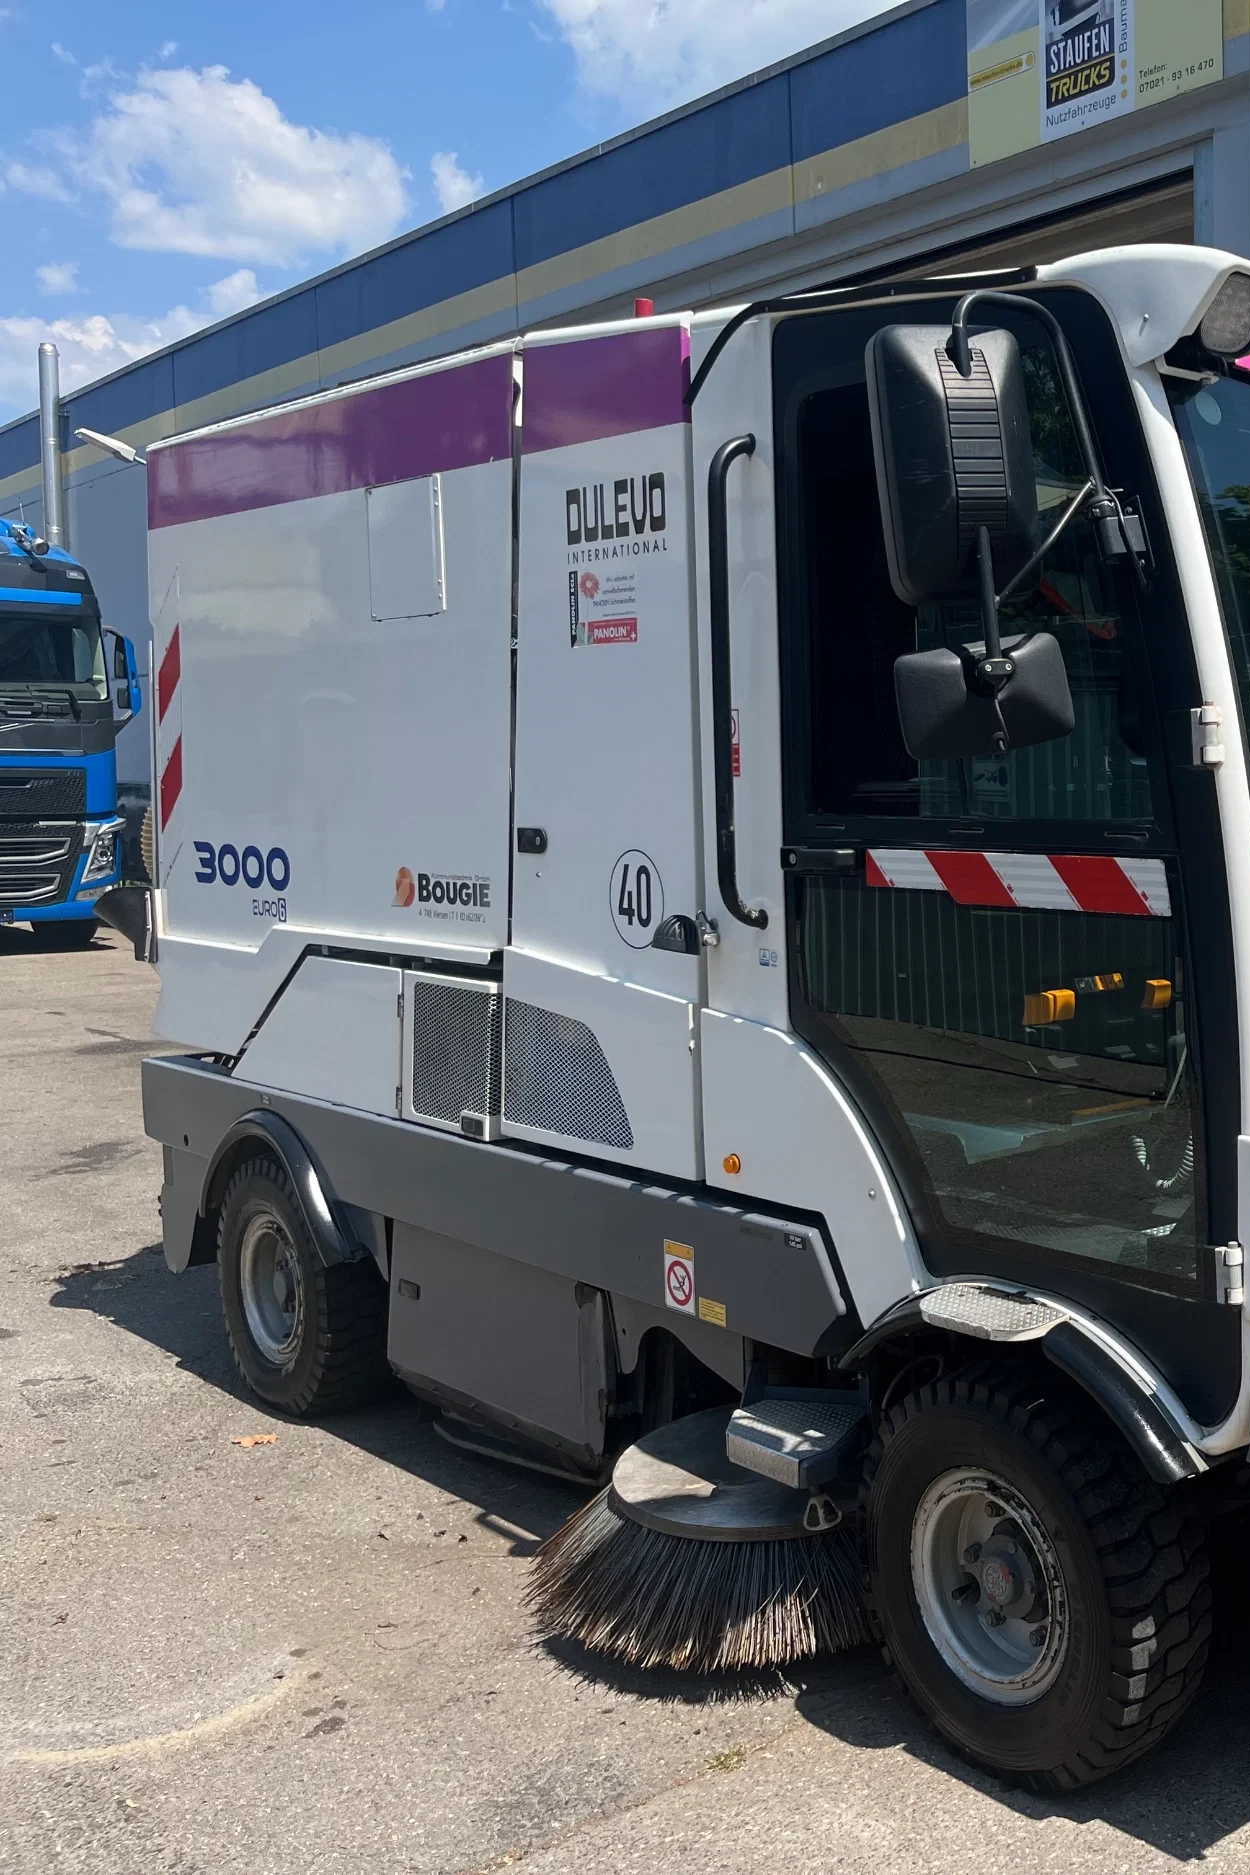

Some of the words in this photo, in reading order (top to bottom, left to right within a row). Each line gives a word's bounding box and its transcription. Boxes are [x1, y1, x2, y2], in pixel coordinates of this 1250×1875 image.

[1050, 24, 1110, 74] STAUFEN
[1050, 61, 1111, 103] TRUCKS
[1139, 63, 1168, 79] Telefon:
[1139, 76, 1165, 93] 07021
[1171, 69, 1183, 82] 93
[1185, 65, 1196, 77] 16
[1197, 58, 1214, 72] 470
[1046, 94, 1117, 128] Nutzfahrzeuge
[566, 472, 666, 546] DULEVO
[567, 538, 668, 565] INTERNATIONAL
[193, 841, 290, 891] 3000
[618, 864, 651, 928] 40
